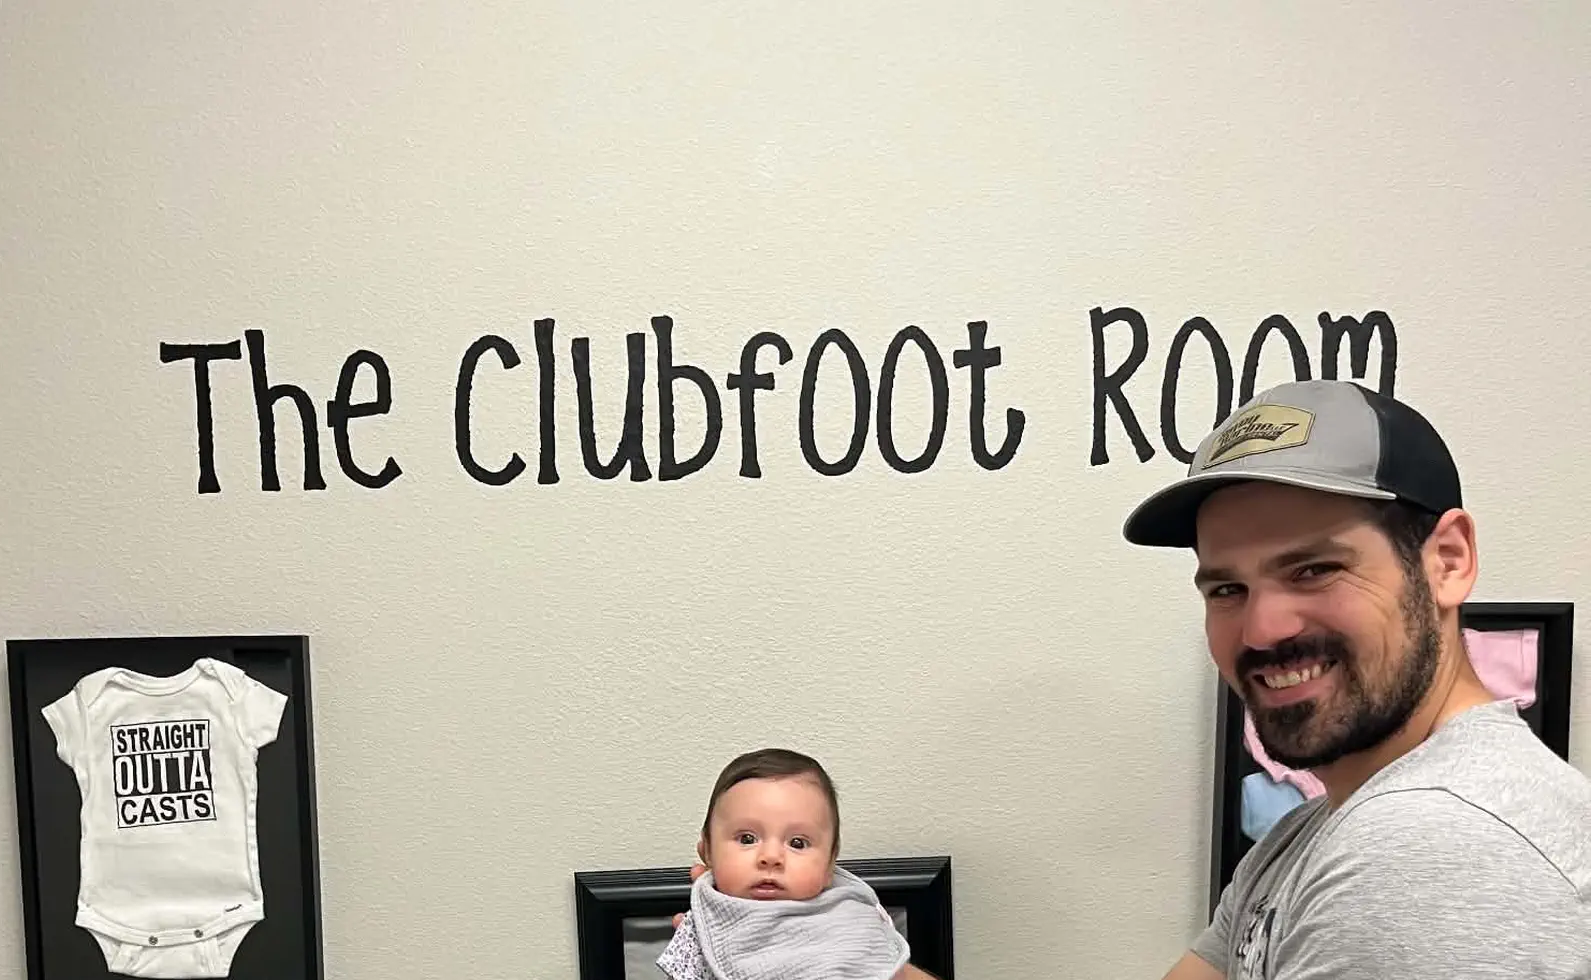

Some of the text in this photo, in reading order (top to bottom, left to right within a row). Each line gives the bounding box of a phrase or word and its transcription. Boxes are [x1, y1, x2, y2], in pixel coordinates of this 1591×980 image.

[160, 306, 1397, 494] The Clubfoot Room
[116, 723, 206, 753] STRAIGHT
[114, 750, 209, 797] OUTTA
[120, 792, 211, 825] CASTS
